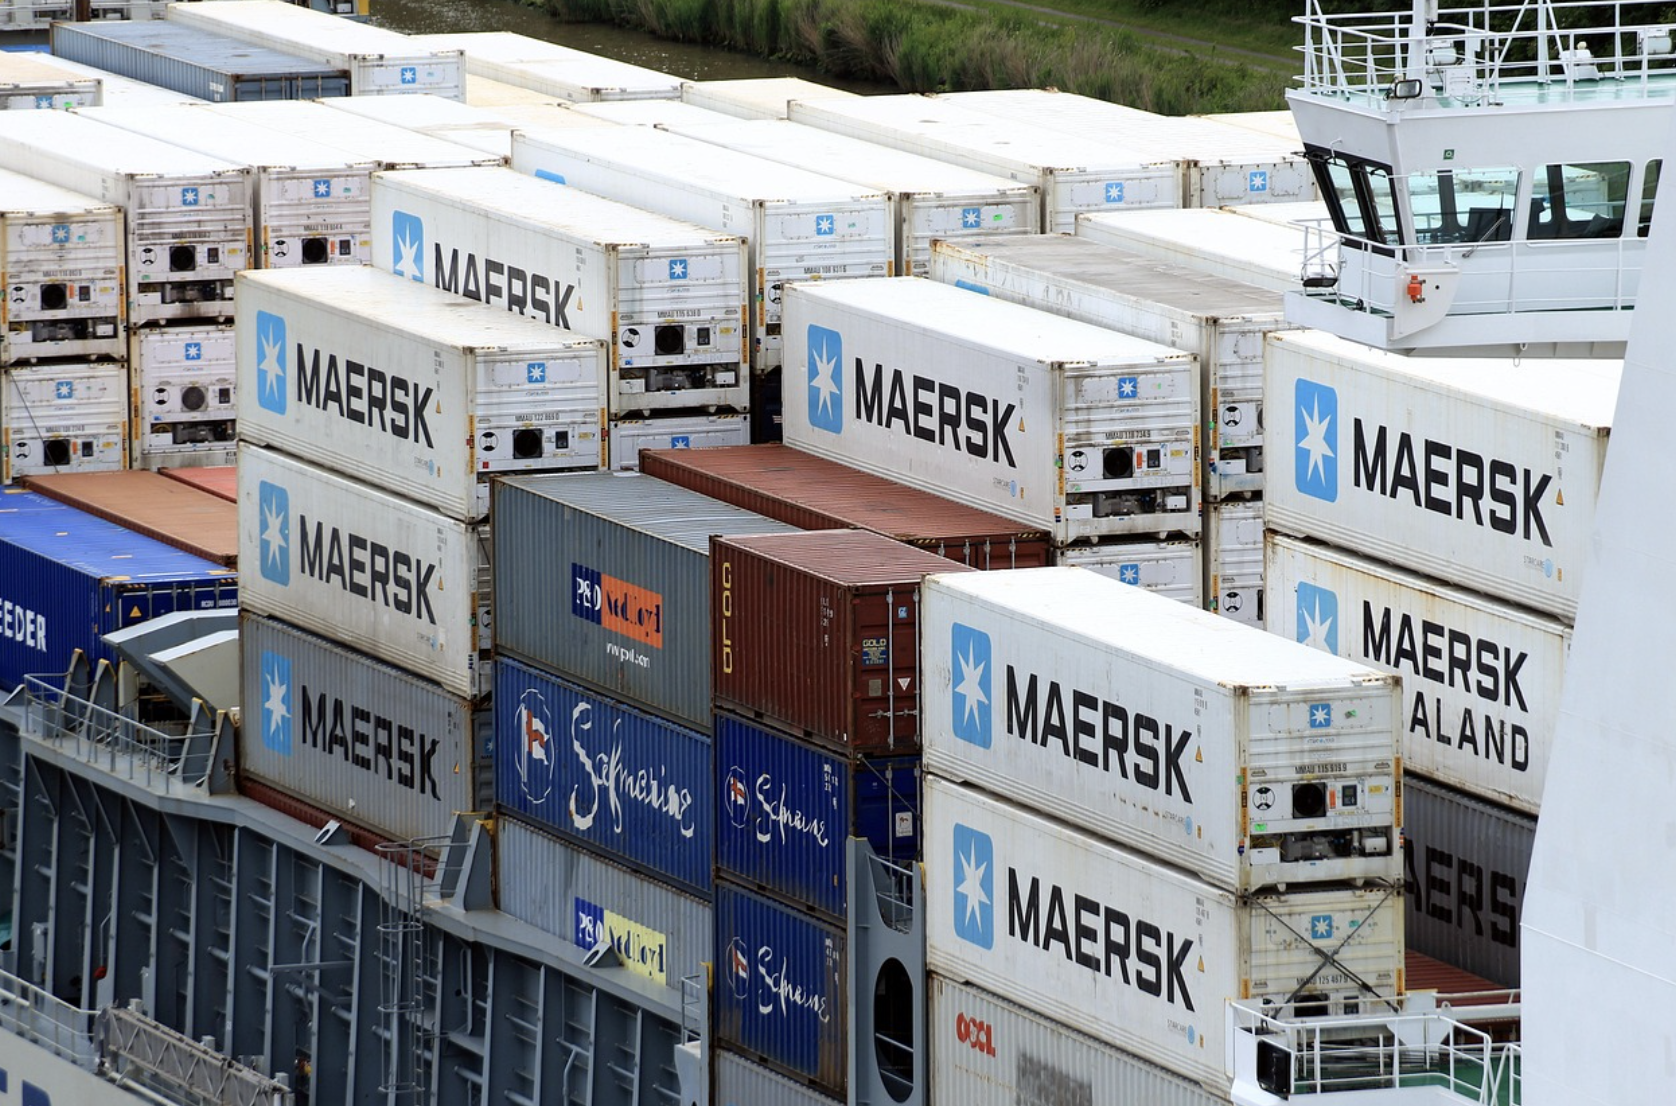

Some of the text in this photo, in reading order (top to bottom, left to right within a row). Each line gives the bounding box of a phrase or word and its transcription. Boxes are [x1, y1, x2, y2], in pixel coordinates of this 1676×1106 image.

[435, 242, 575, 331] MAERSK
[297, 343, 434, 449] MAERSK
[855, 357, 1017, 469] MAERSK
[1354, 417, 1553, 547] MAERSK
[0, 597, 47, 653] EDER
[299, 514, 437, 625] MAERSK
[576, 577, 601, 611] P&O
[722, 562, 733, 674] GOLD
[1363, 599, 1529, 713] MAERSK
[301, 684, 442, 802] MAERSK
[569, 701, 696, 840] Safmarine
[1006, 664, 1193, 805] MAERSK
[1409, 691, 1529, 772] ALAND
[1008, 866, 1195, 1013] MAERSK
[1404, 836, 1526, 949] AERS
